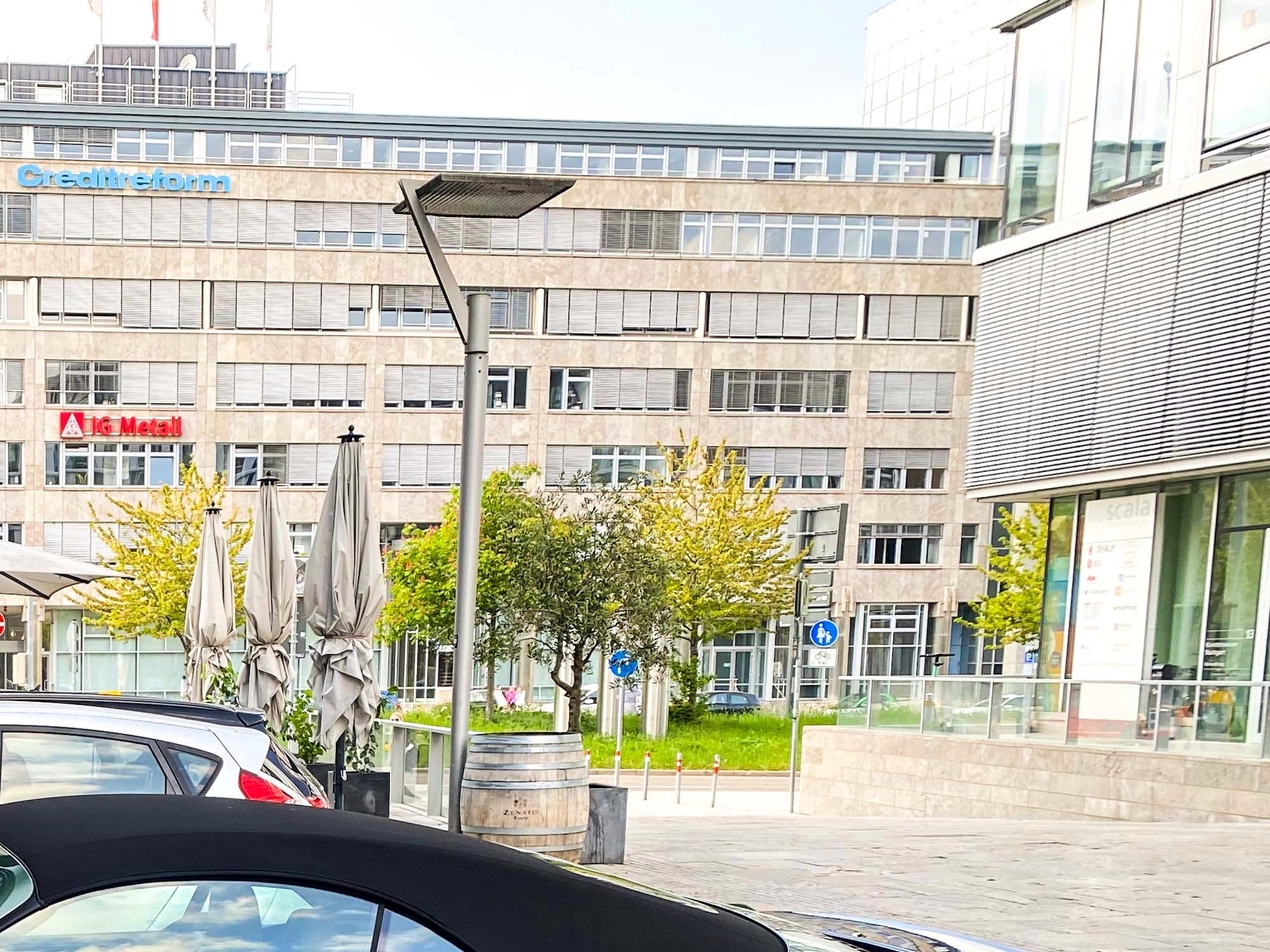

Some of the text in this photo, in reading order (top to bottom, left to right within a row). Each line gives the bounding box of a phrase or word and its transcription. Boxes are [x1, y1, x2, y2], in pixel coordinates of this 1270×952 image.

[17, 163, 230, 193] Creditreform
[91, 416, 182, 437] IG Metall
[1106, 496, 1150, 521] scala
